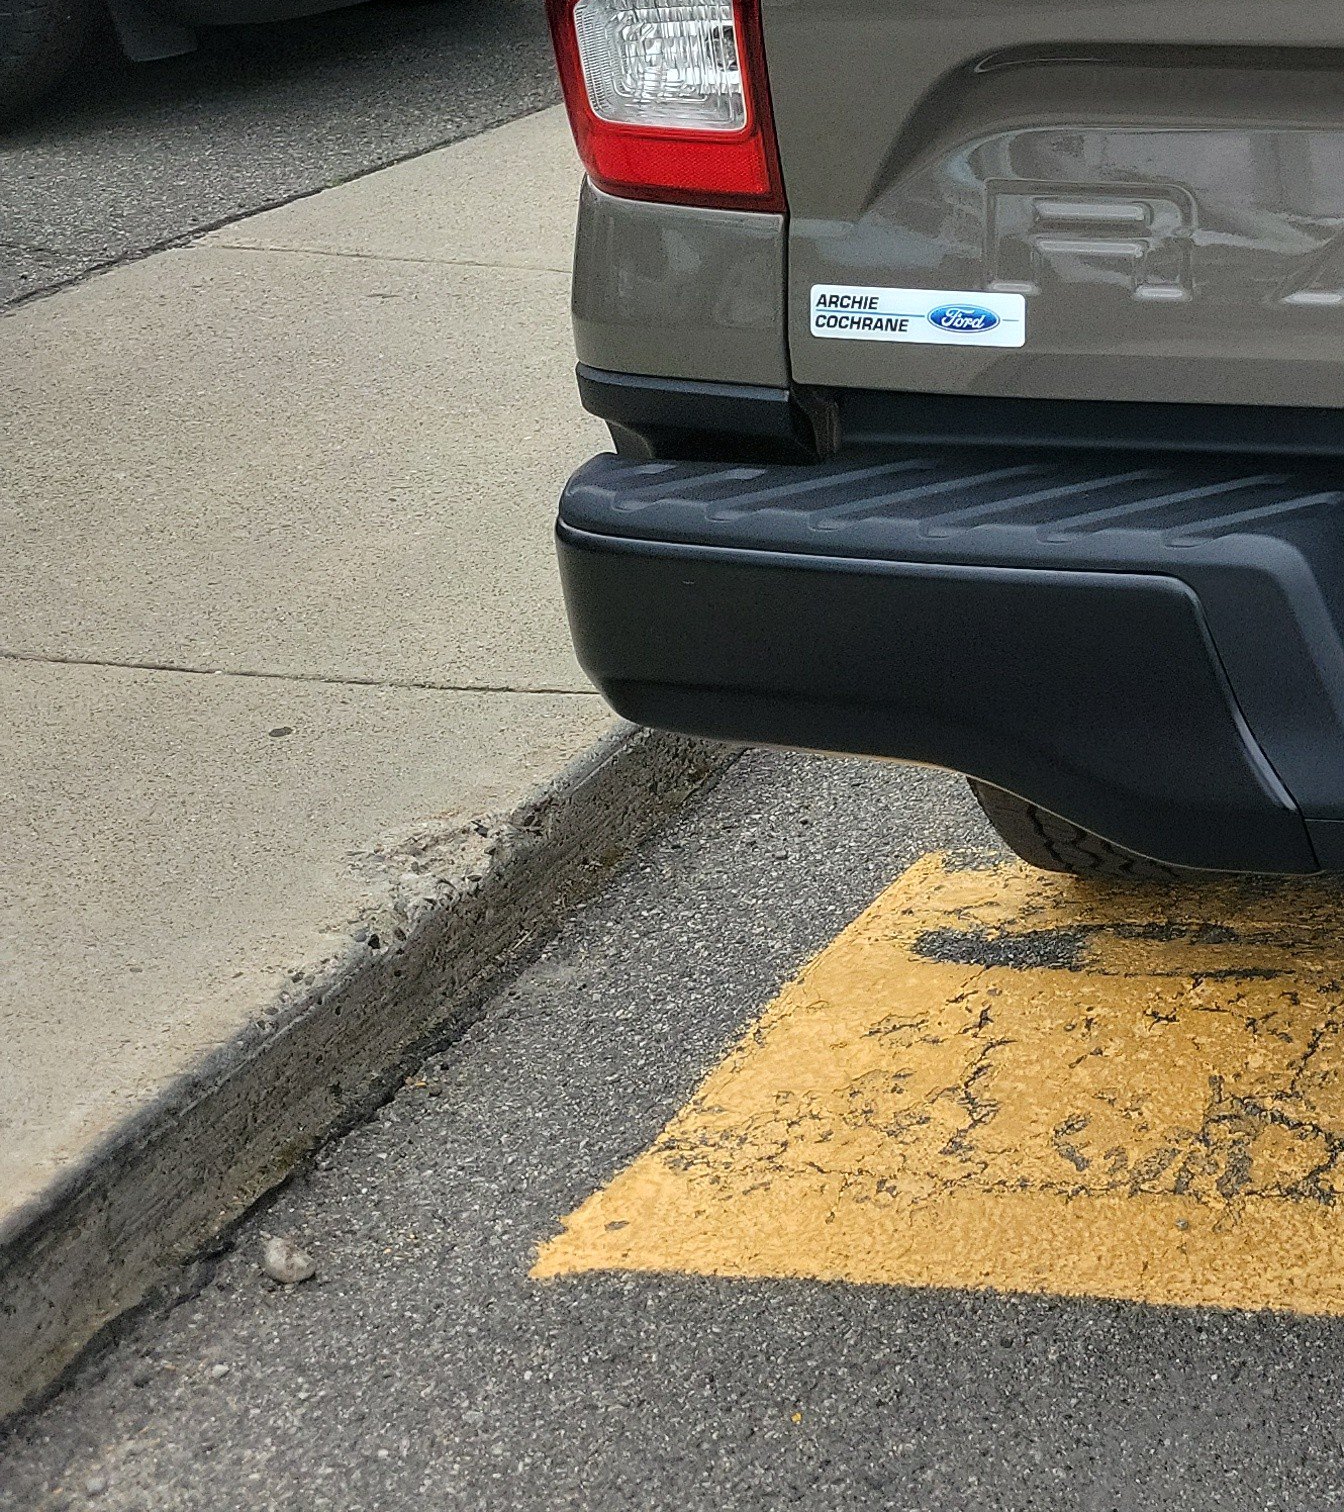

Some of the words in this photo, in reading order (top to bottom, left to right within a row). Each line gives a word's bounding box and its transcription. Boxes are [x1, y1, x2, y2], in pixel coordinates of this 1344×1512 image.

[815, 294, 879, 310] ARCHIE
[815, 314, 909, 332] COCHRANE
[941, 307, 986, 330] Ford
